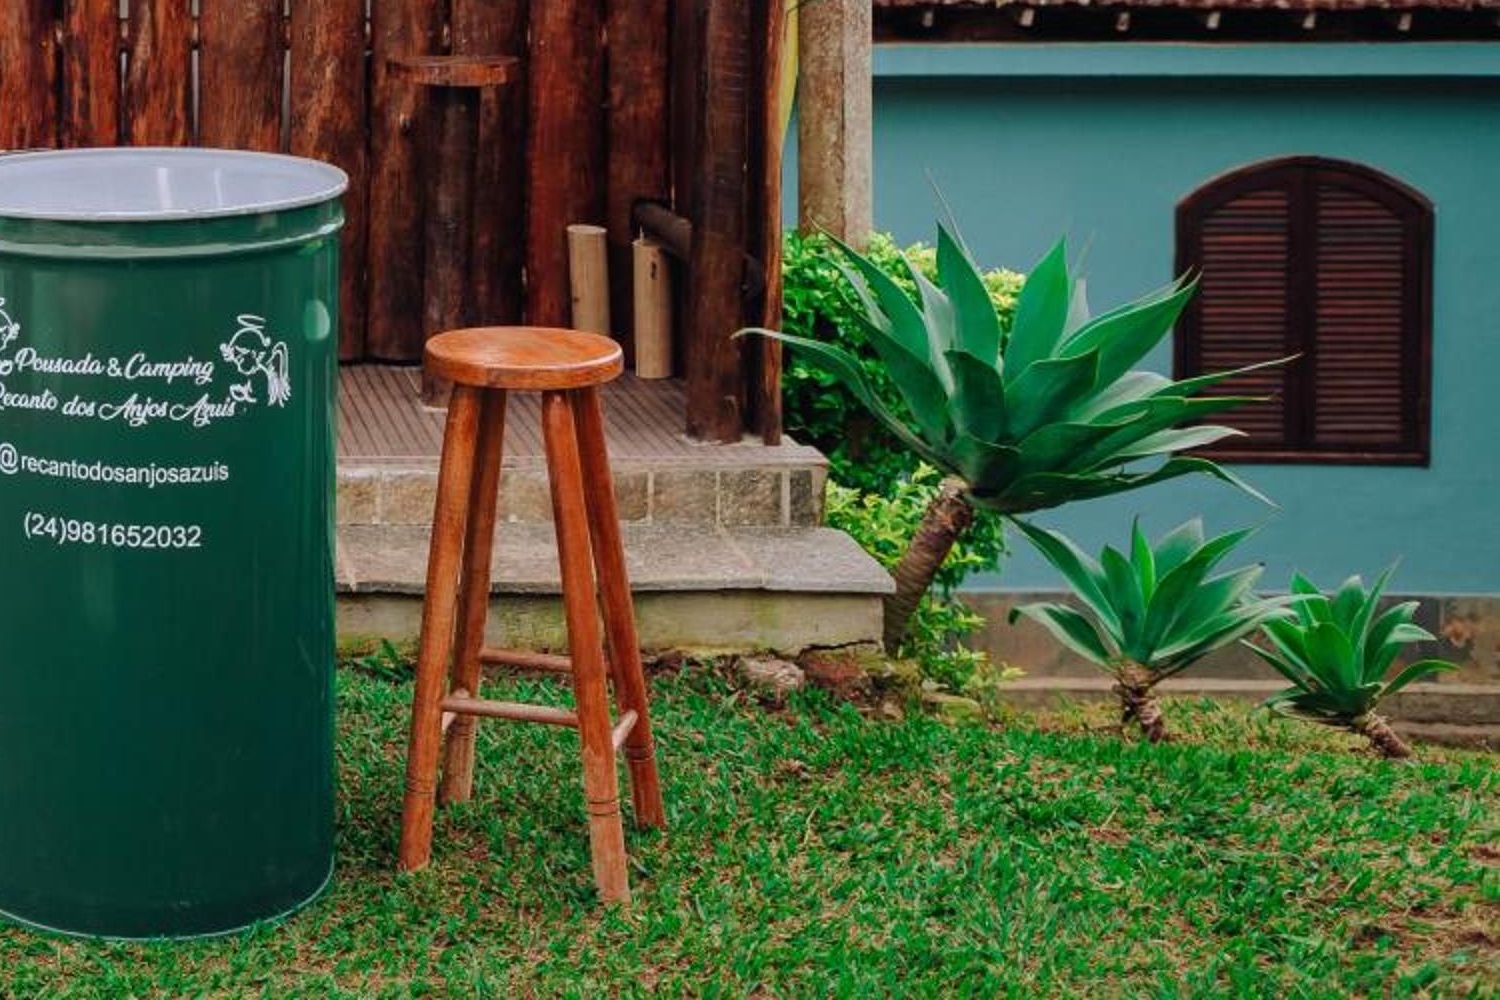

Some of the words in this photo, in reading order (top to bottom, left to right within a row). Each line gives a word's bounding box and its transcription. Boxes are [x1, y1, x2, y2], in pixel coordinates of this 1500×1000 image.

[13, 346, 105, 378] Pousada
[106, 356, 123, 378] &
[123, 352, 215, 386] Camping
[61, 394, 97, 417] dos
[98, 392, 168, 428] Anjos
[168, 392, 237, 428] Azuis
[23, 511, 202, 549] (24)981652032
